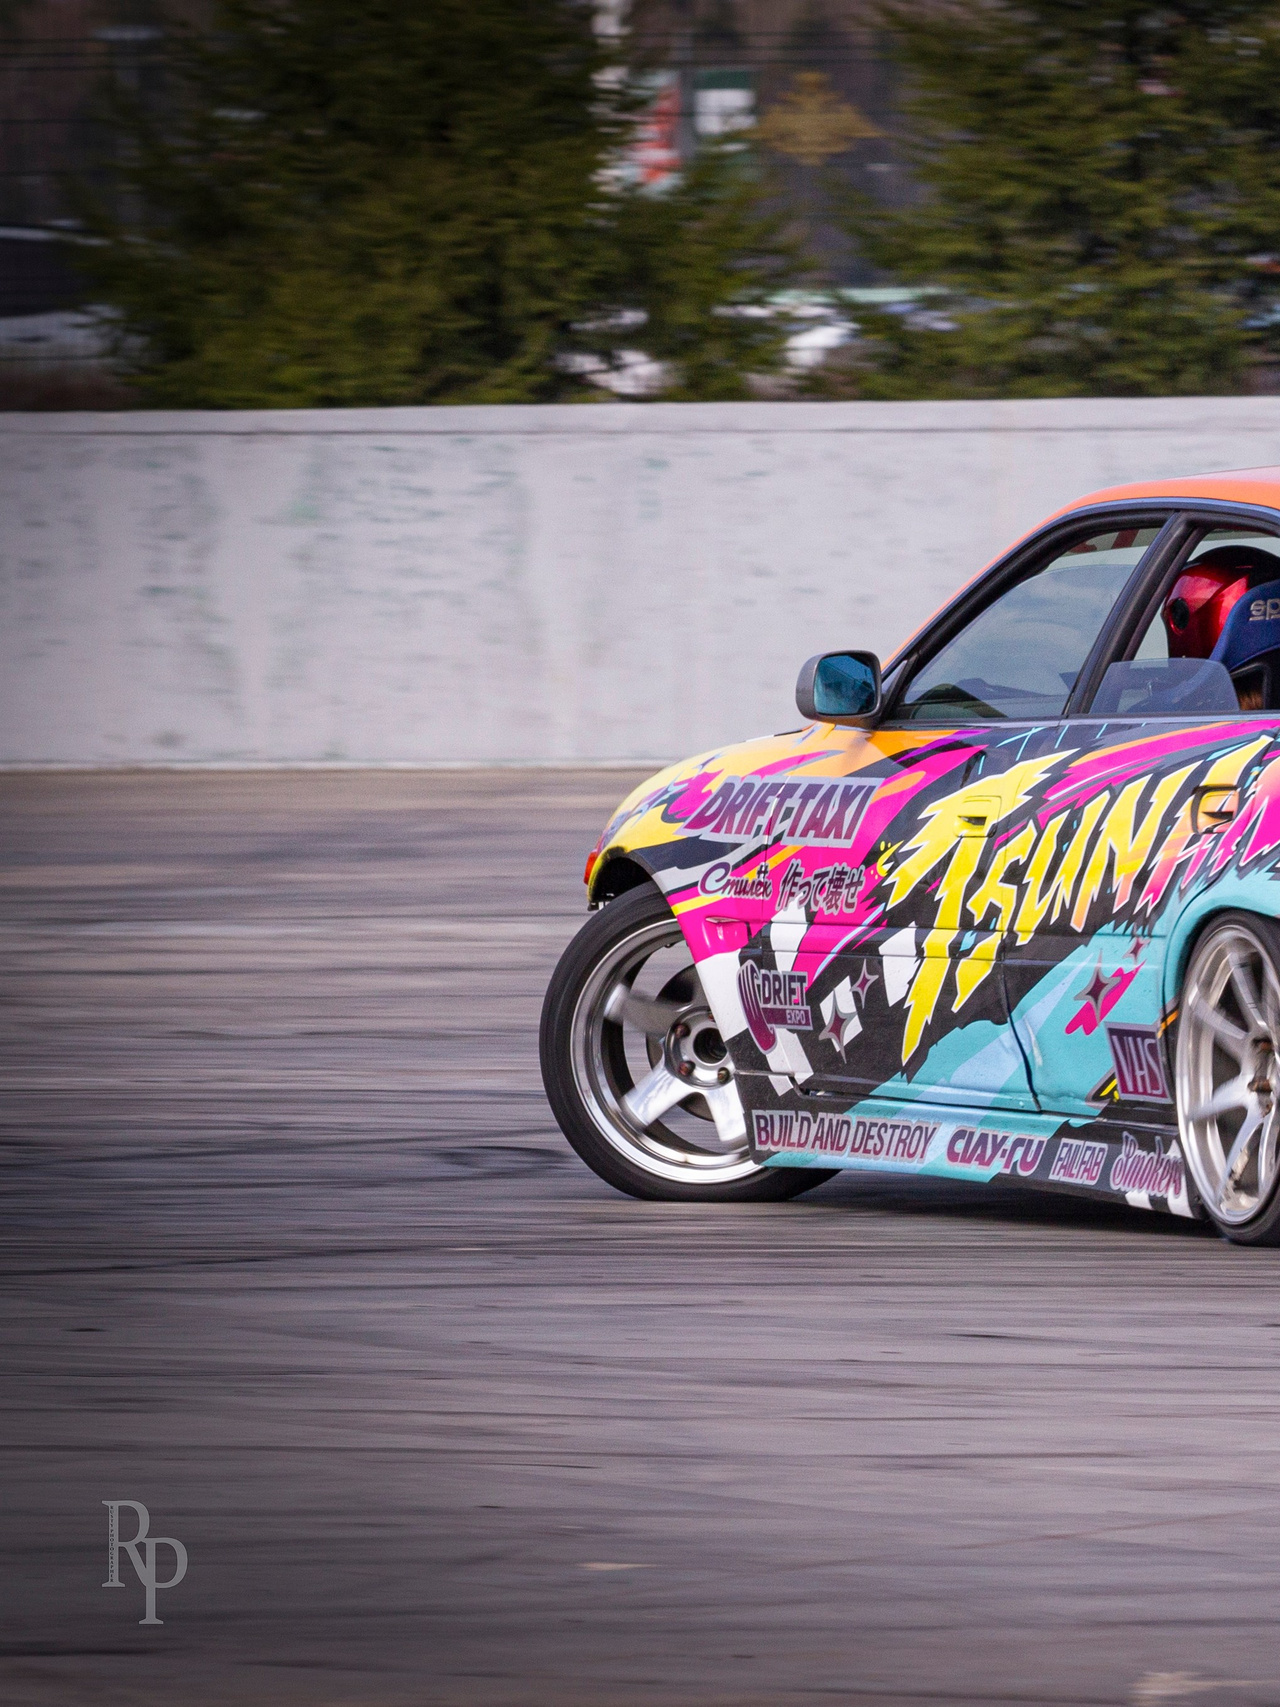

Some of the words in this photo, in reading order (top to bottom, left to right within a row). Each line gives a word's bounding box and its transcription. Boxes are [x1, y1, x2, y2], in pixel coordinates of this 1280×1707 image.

[761, 973, 807, 1006] DRIFT
[786, 1009, 806, 1024] EXPO
[1111, 1035, 1164, 1095] VHS
[755, 1114, 811, 1149] BUILD
[811, 1117, 851, 1152] AND
[851, 1121, 937, 1160] DESTROY
